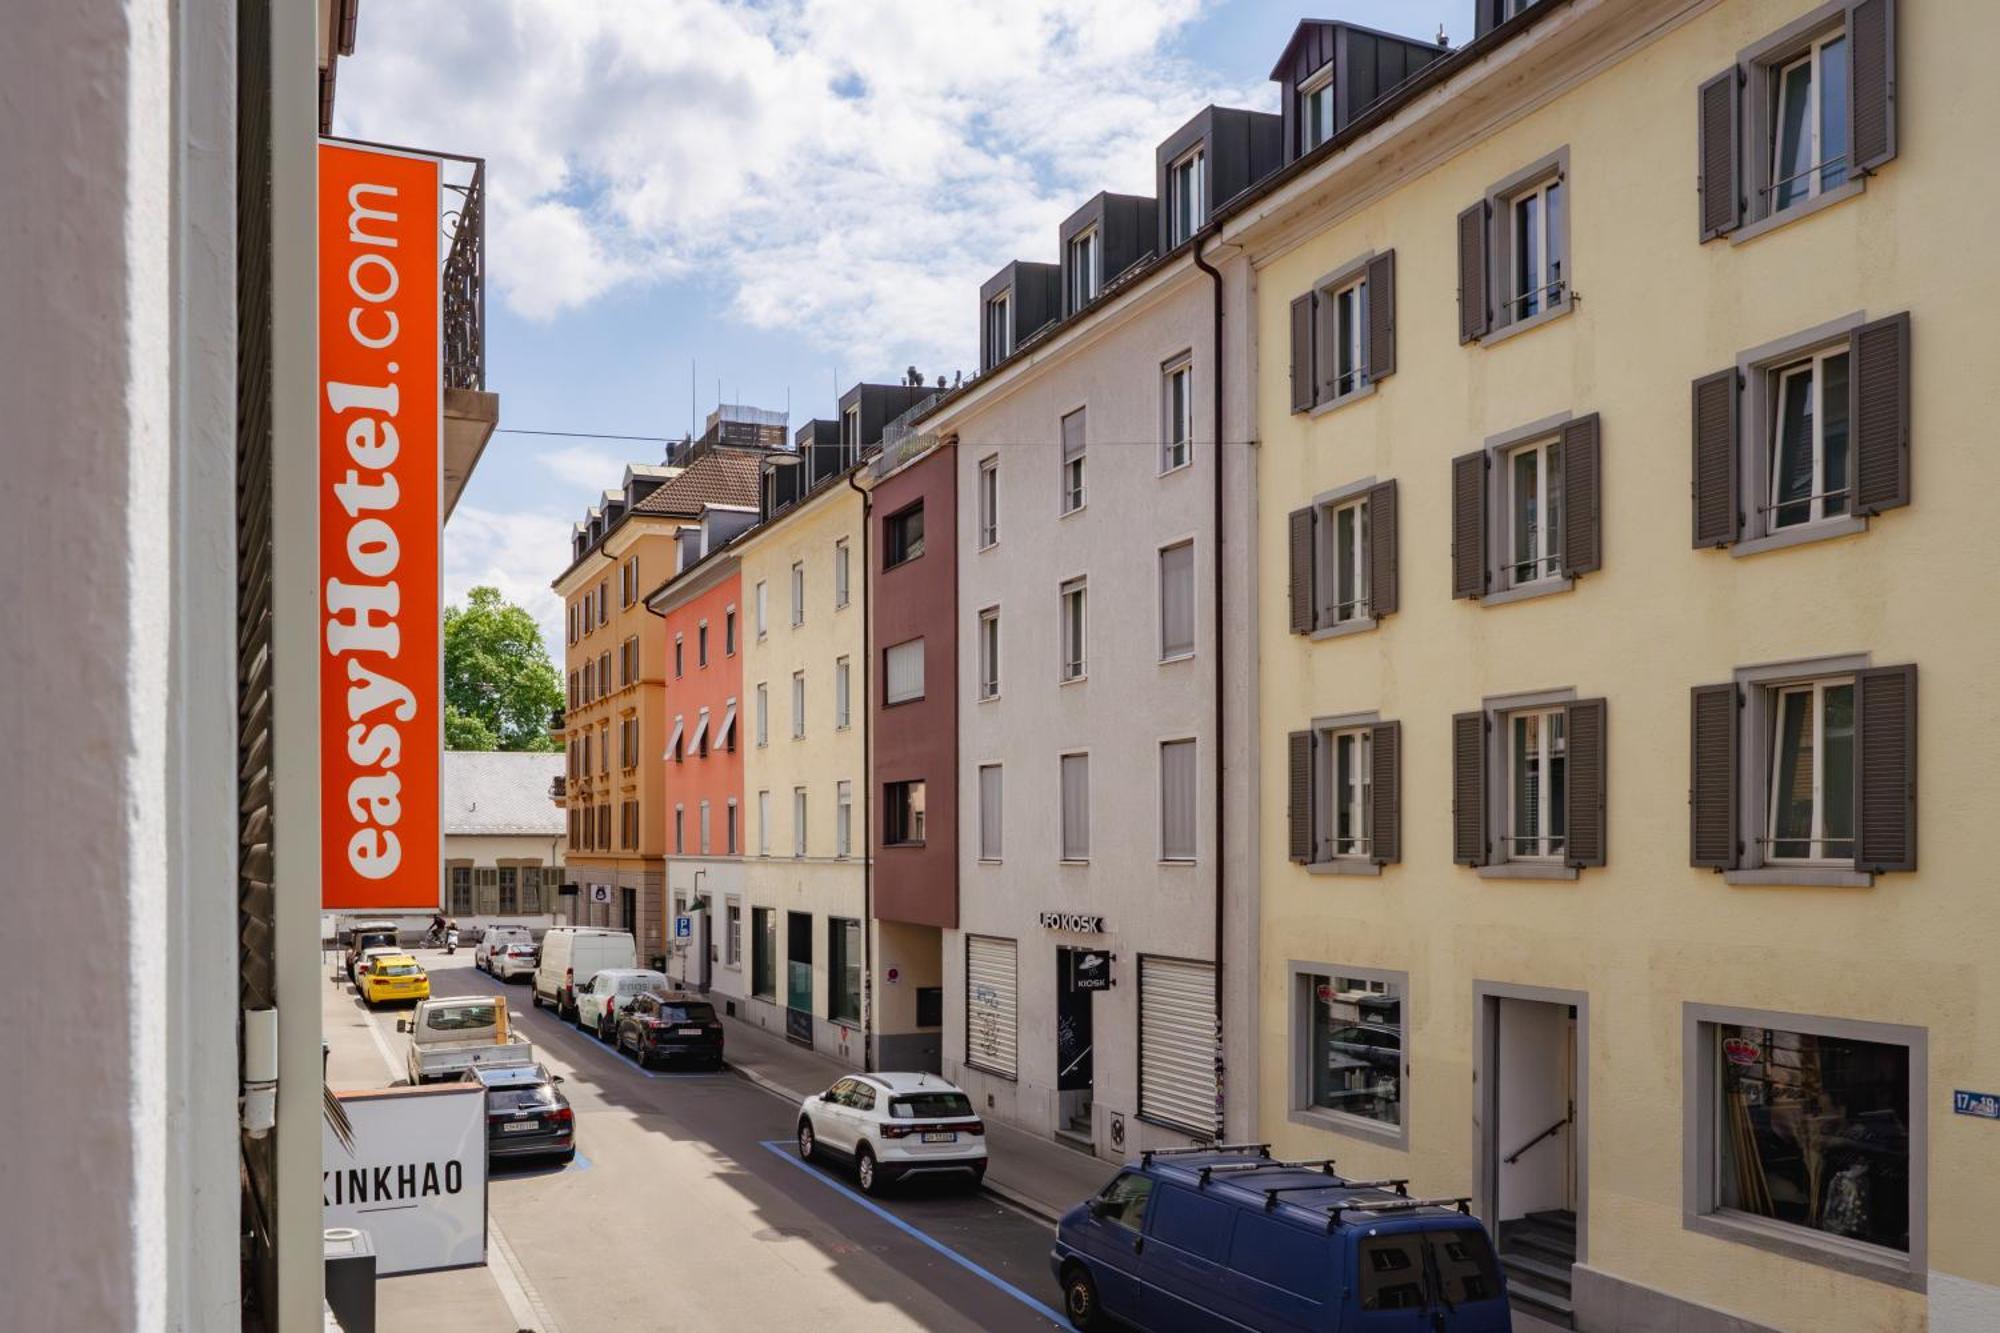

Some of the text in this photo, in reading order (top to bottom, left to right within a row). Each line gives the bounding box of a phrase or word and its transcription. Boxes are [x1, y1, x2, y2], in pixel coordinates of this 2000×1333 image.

[326, 183, 416, 880] easyHotel.com
[1061, 914, 1099, 933] KIOSK
[1078, 979, 1105, 987] KIOSK
[1957, 1093, 1969, 1109] 17
[324, 1160, 462, 1206] INKHAO
